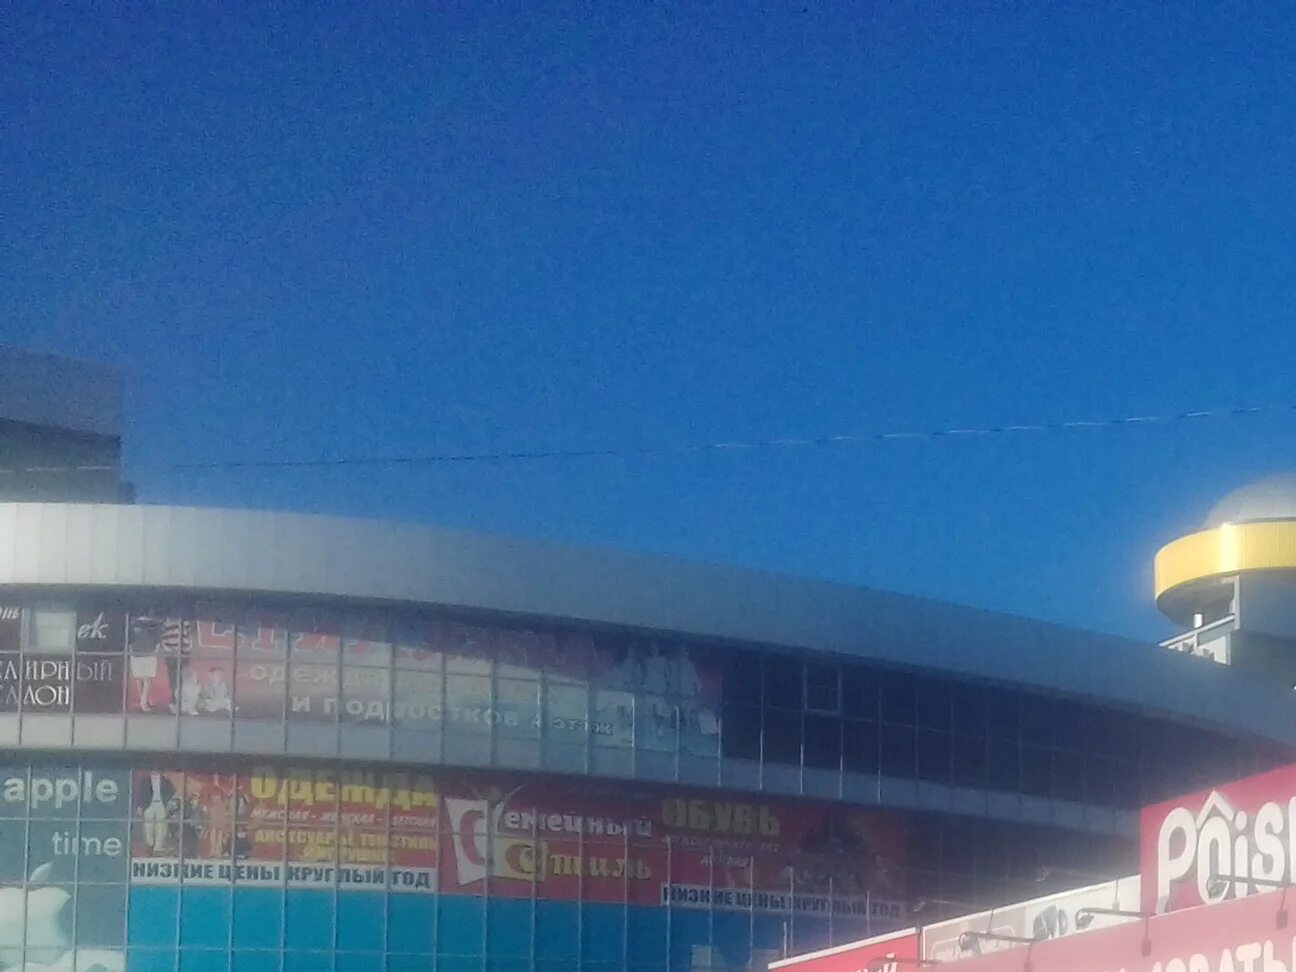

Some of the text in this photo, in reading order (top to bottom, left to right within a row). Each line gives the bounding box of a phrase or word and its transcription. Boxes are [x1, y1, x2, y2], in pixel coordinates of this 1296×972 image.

[0, 659, 112, 681] ЛИРНЫЙ
[0, 685, 70, 706] АЛОН
[4, 769, 118, 809] apple
[662, 798, 781, 836] ОБУВЬ
[52, 831, 122, 856] time
[132, 862, 431, 890] НИЗКИЕ ЦЕНЫ КРУГЛЫЙ ГОД
